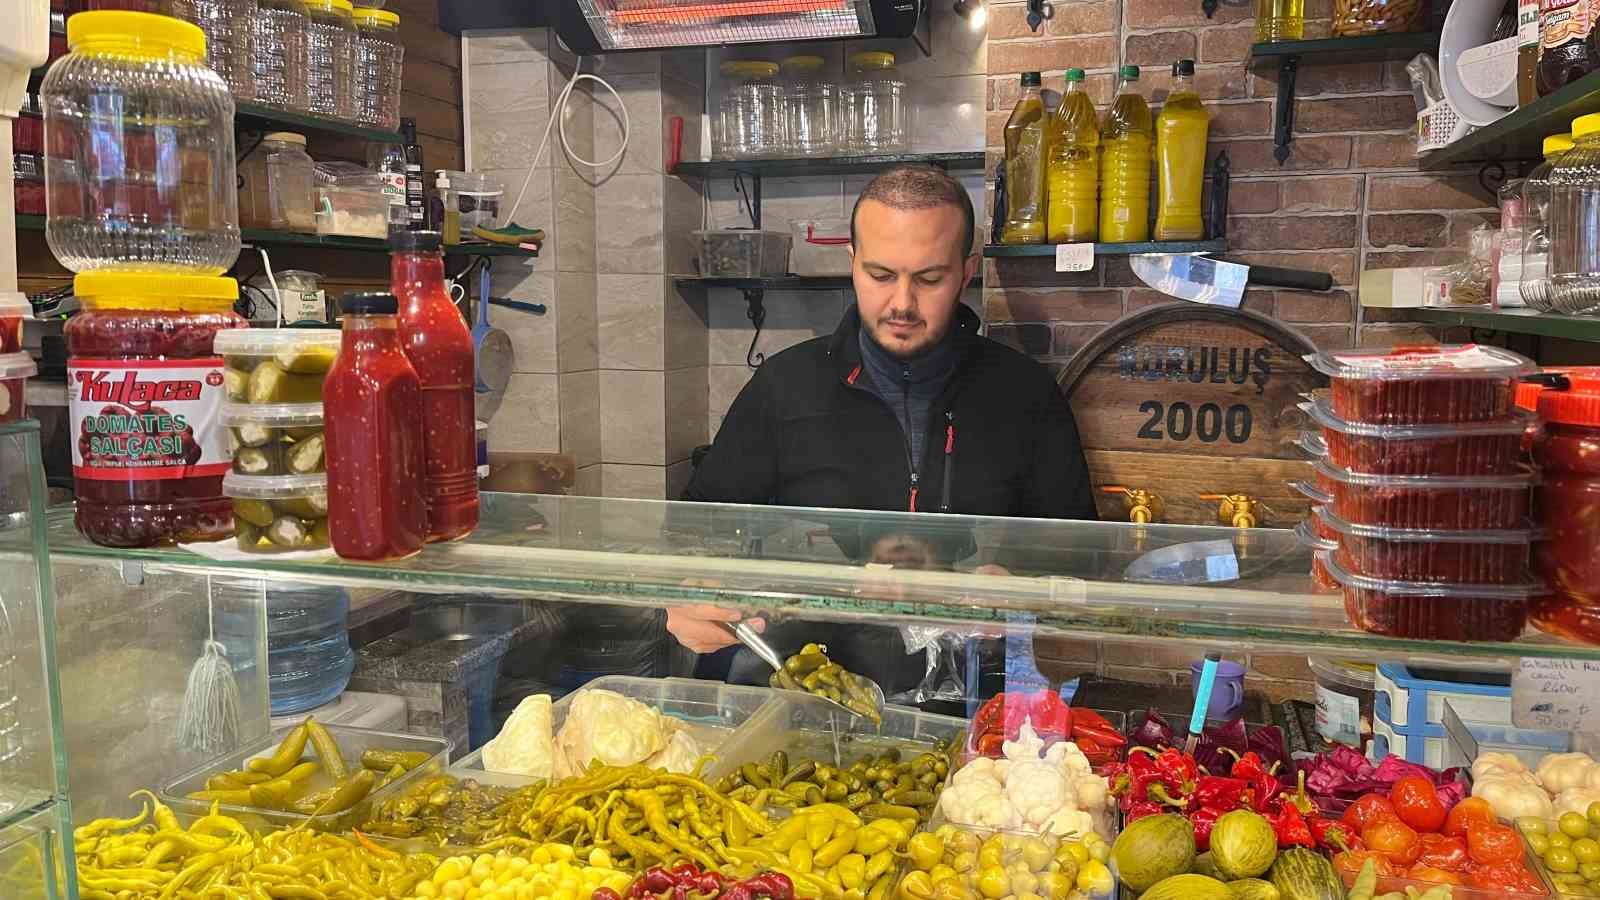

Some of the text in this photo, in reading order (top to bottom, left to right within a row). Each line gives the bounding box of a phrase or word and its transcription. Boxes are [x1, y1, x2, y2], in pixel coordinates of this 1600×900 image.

[1119, 345, 1271, 394] KURULUŞ
[86, 413, 188, 434] DOMATES
[1136, 399, 1252, 445] 2000
[90, 434, 182, 459] SALÇASI
